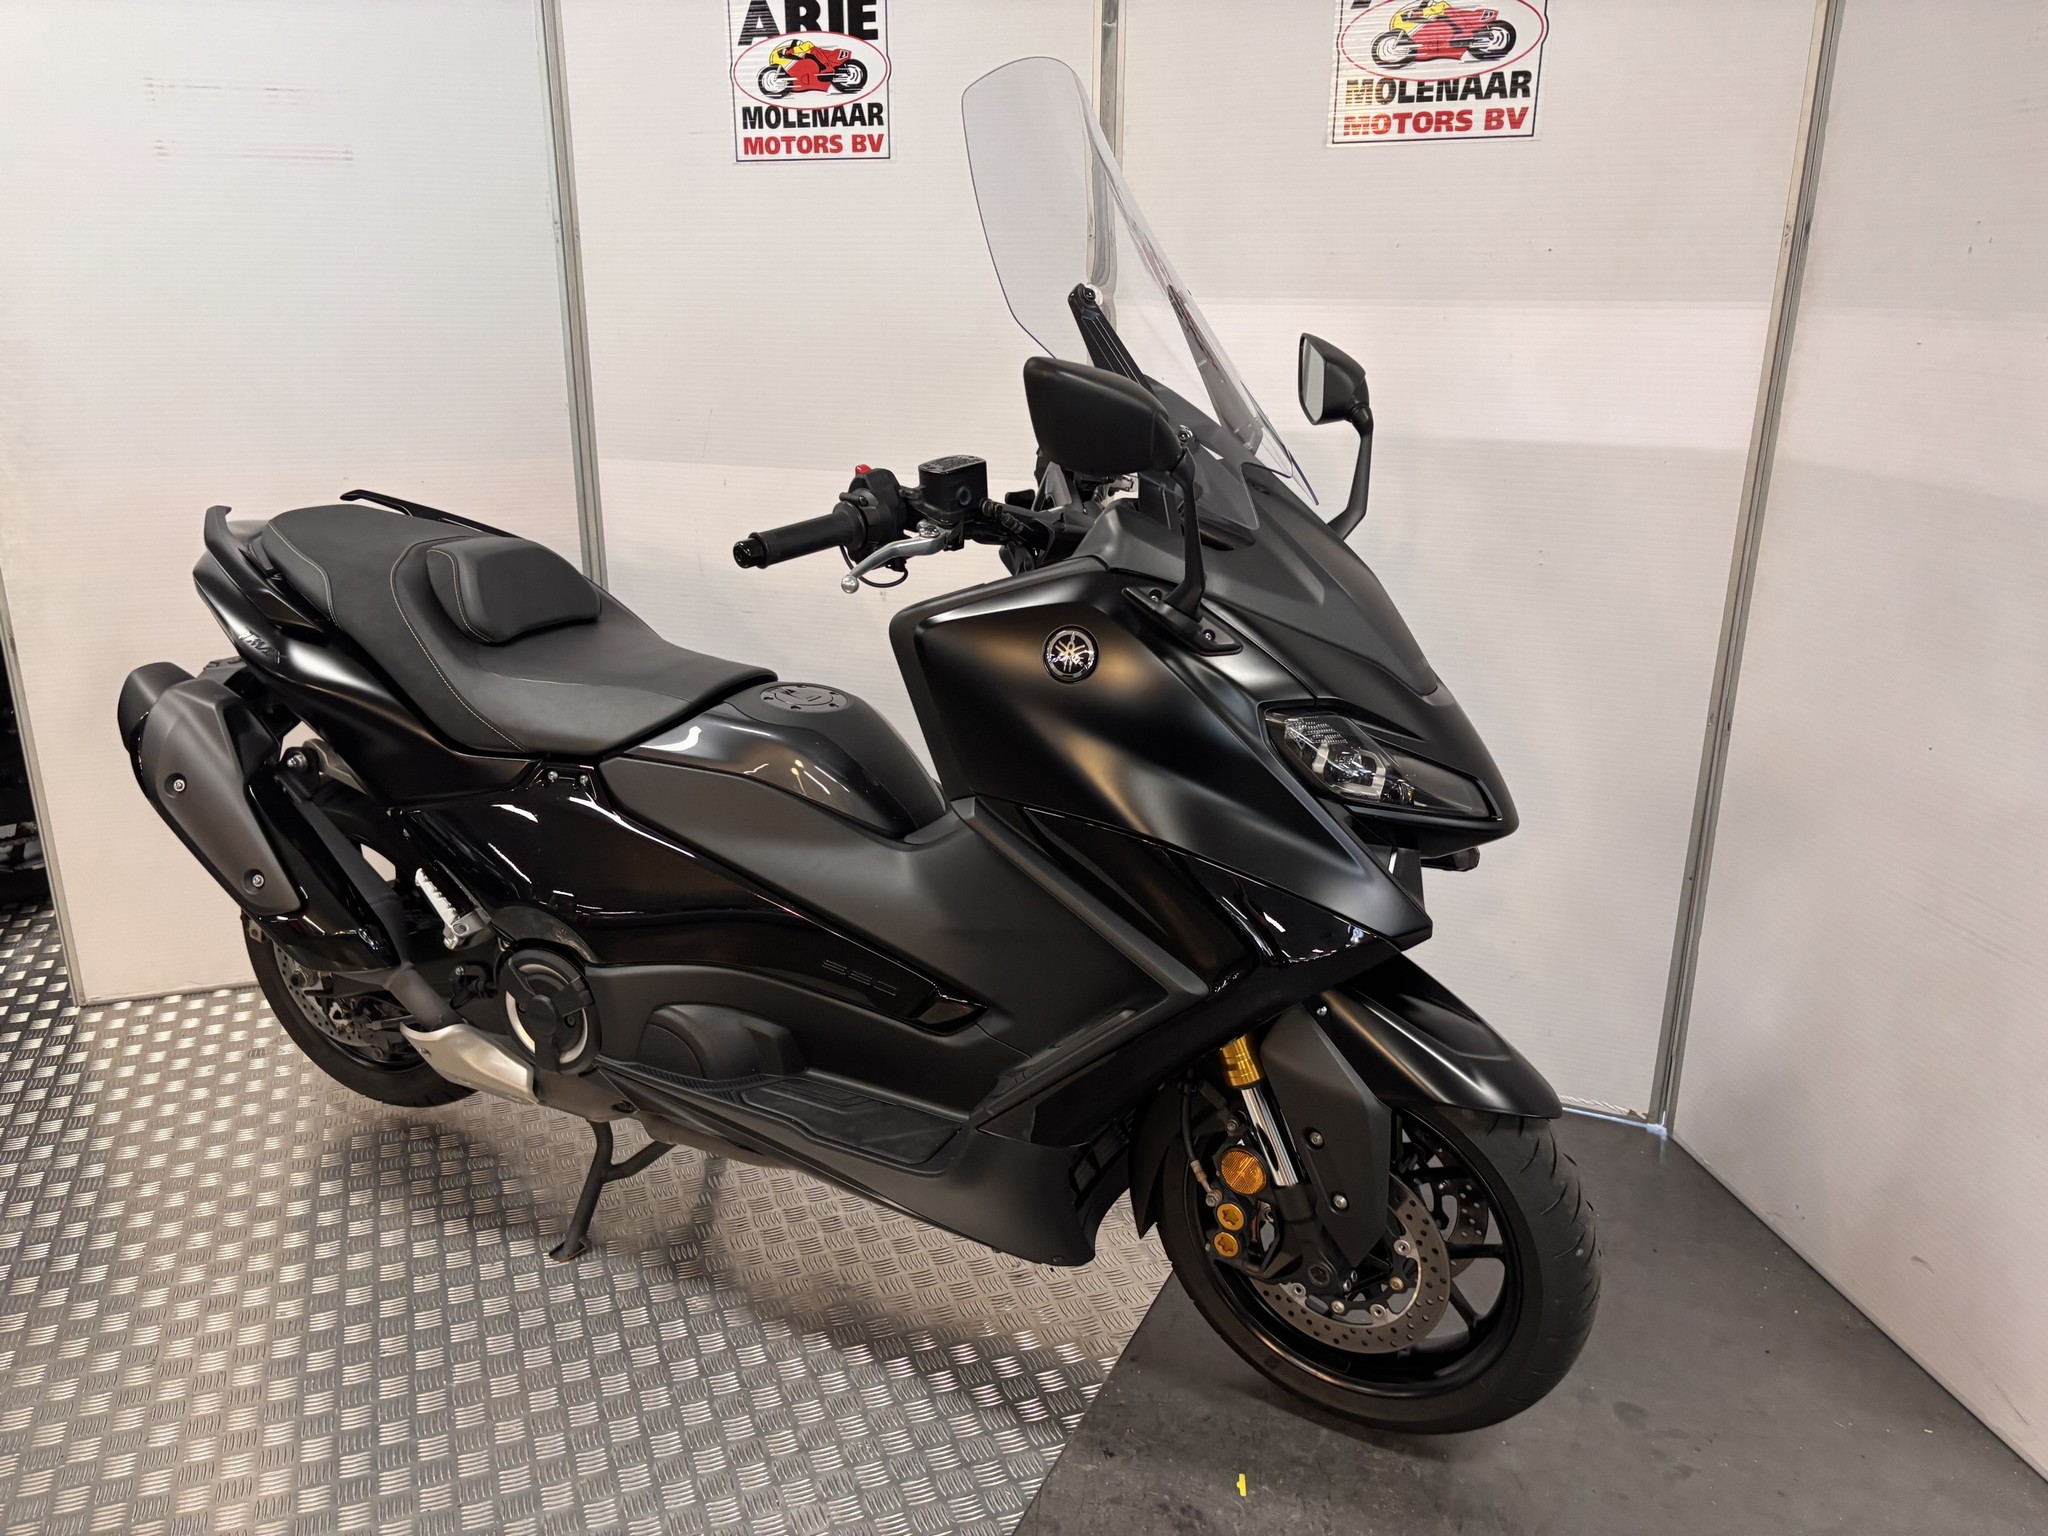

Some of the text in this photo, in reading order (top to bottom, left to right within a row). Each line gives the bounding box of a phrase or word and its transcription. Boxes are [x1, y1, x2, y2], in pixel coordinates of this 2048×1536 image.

[738, 0, 878, 46] ARIE
[1345, 70, 1532, 105] MOLENAAR
[742, 103, 884, 129] MOLENAAR
[1343, 107, 1529, 136] MOTORS BV
[743, 134, 884, 155] MOTORS BV
